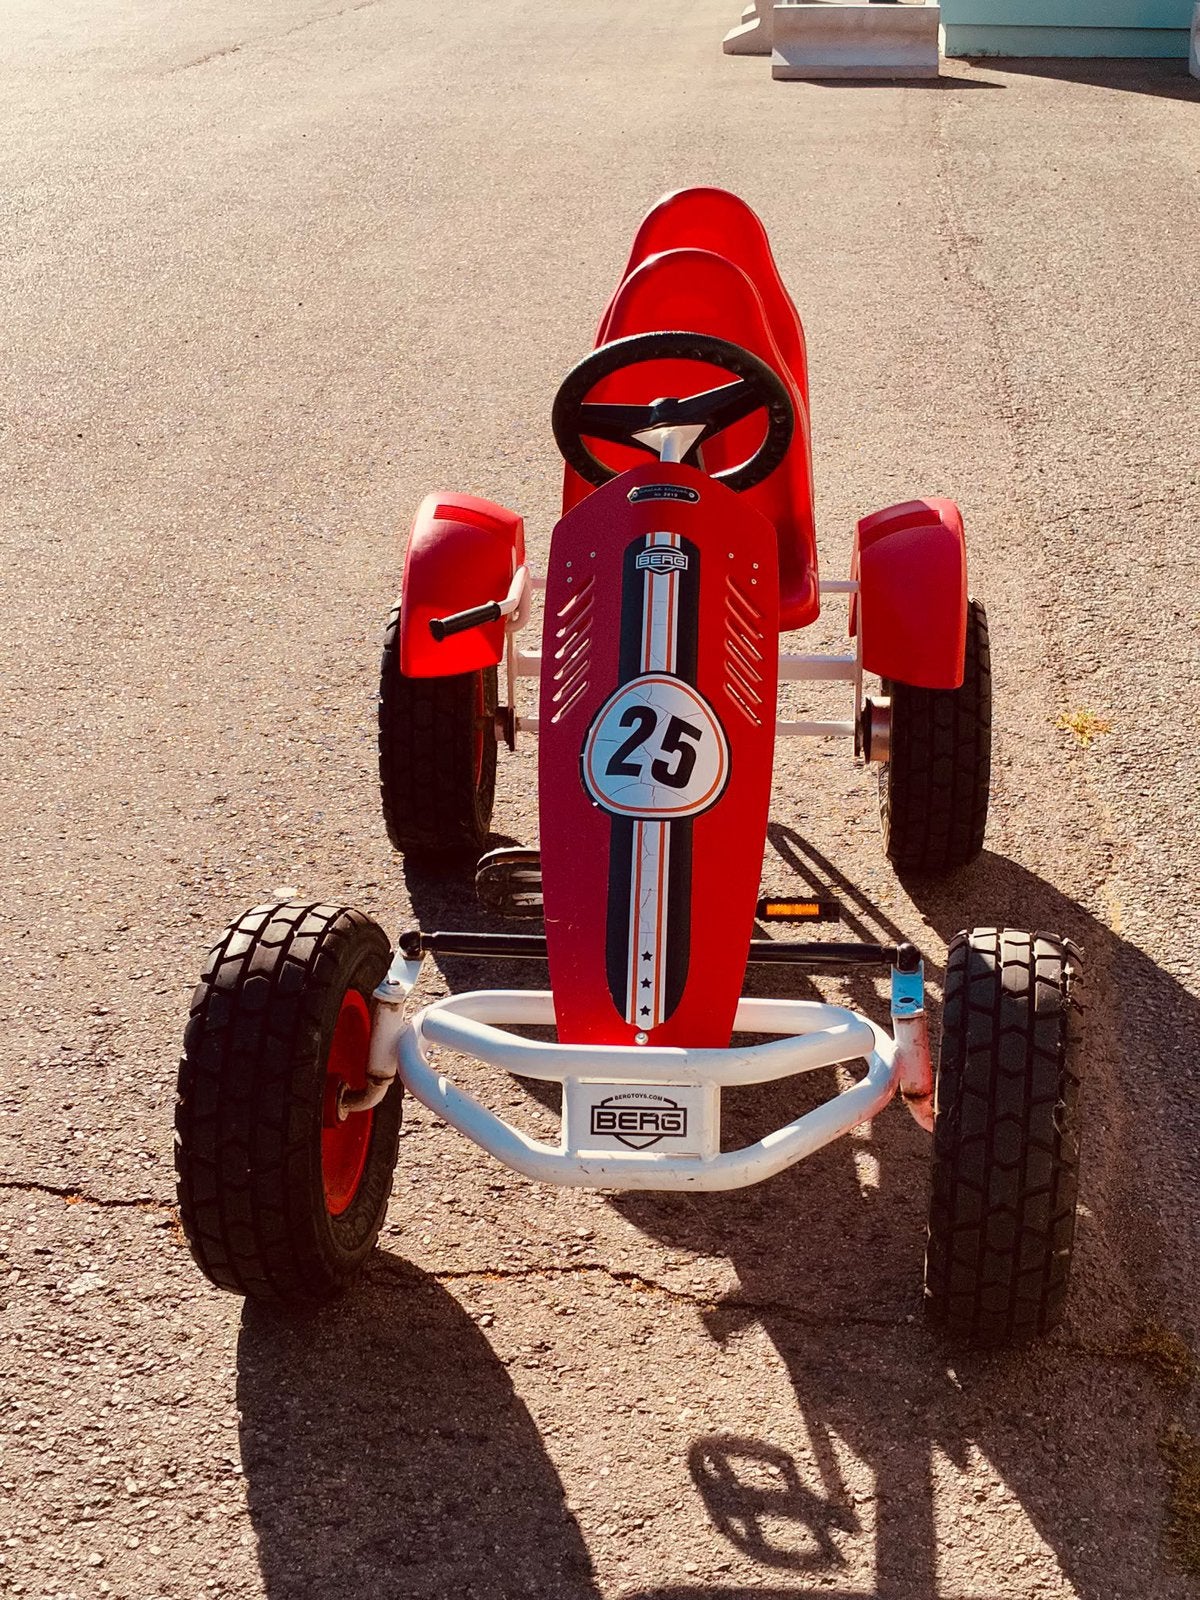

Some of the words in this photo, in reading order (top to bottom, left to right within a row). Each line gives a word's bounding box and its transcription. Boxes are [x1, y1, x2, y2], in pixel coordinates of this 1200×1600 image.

[639, 555, 685, 566] BERG
[605, 705, 703, 789] 25
[614, 1093, 663, 1101] BERGTOYS.COM
[596, 1111, 681, 1131] BERG
